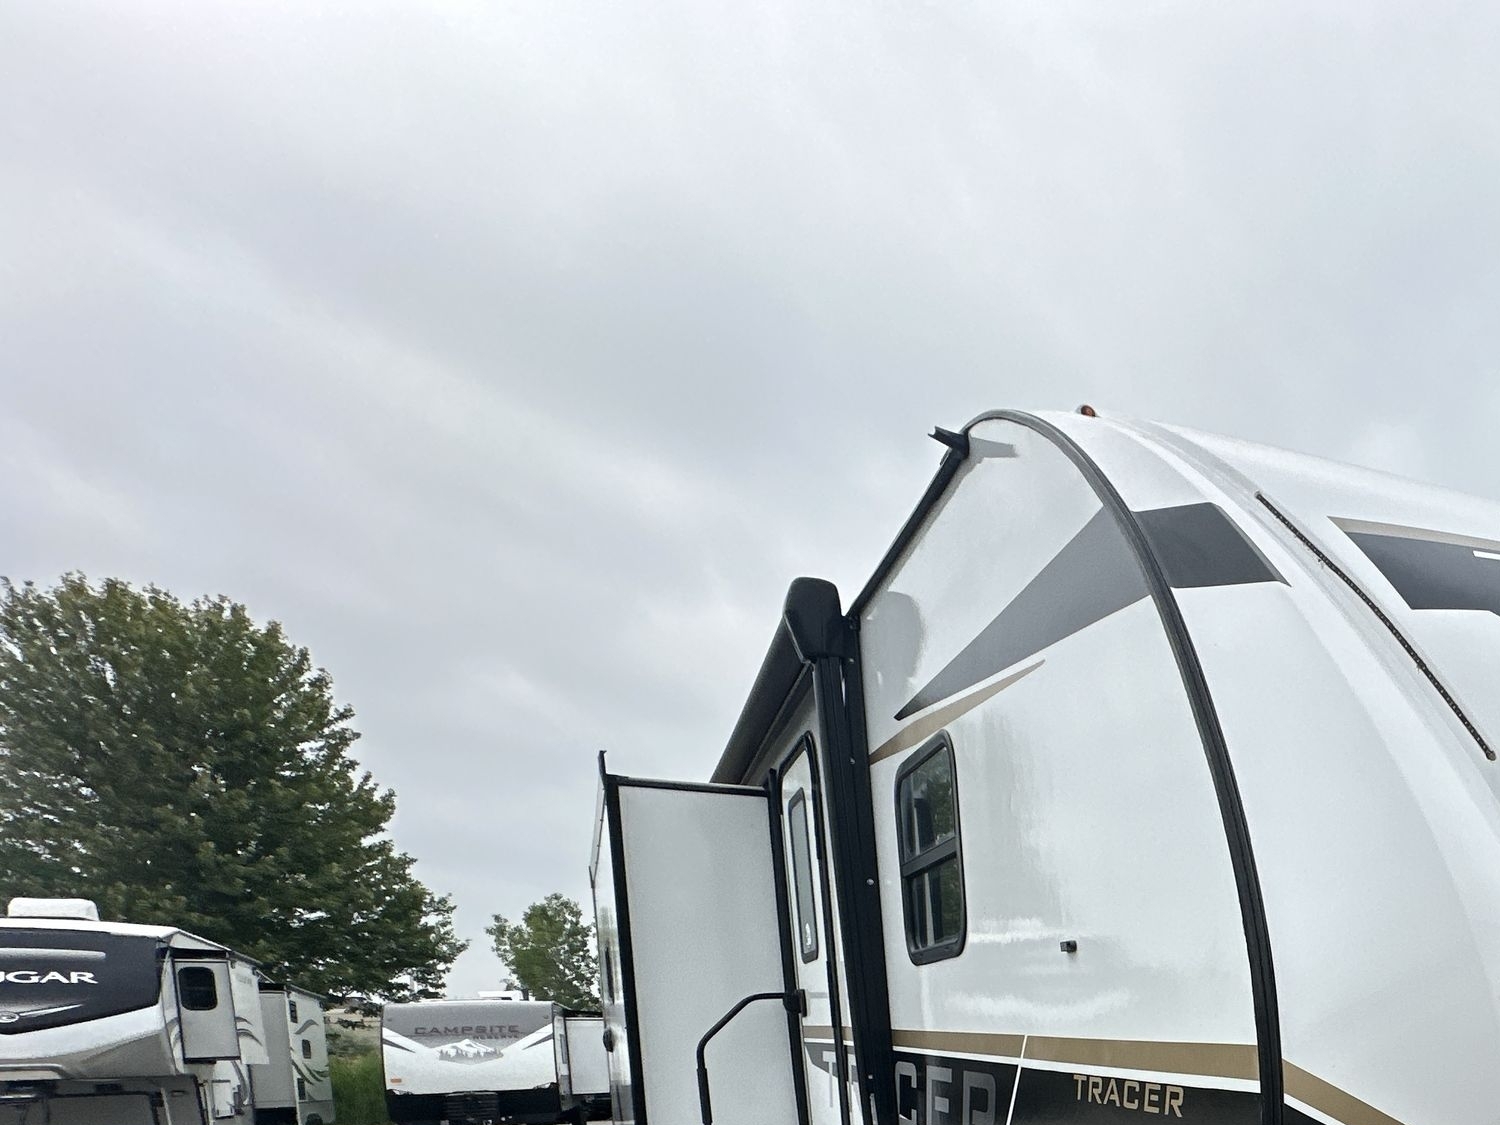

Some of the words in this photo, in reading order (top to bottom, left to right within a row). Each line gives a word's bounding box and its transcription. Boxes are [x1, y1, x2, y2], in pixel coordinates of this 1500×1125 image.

[0, 970, 99, 984] GAR
[414, 1024, 519, 1035] CAMPSITE
[1073, 1074, 1184, 1118] TRACER
